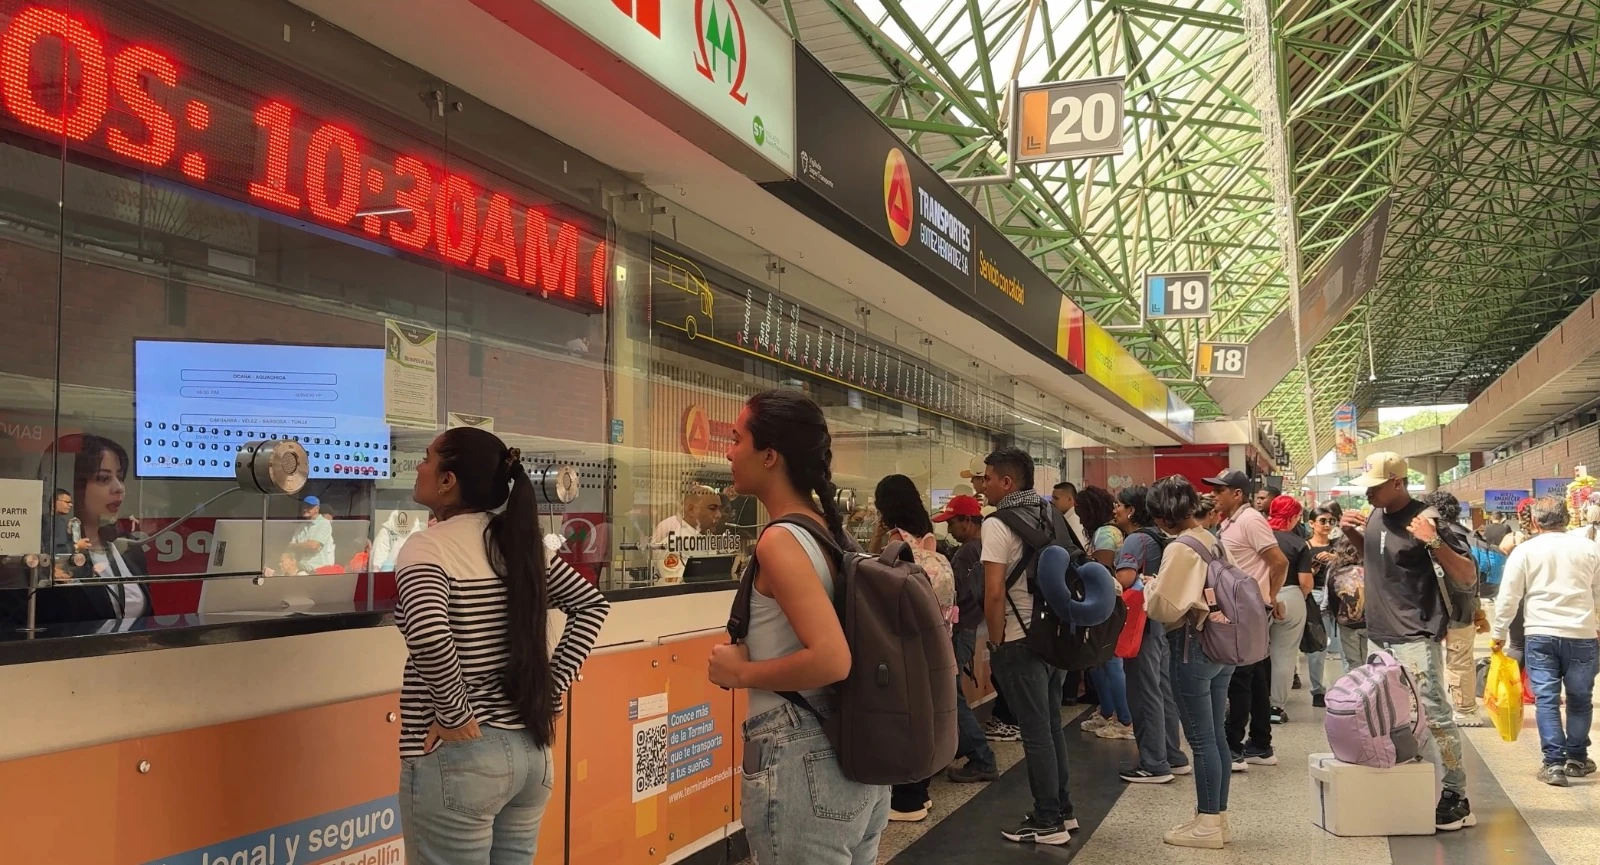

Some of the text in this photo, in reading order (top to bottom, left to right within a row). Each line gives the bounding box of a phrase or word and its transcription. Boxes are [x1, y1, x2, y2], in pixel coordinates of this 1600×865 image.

[1050, 92, 1115, 145] 20
[249, 100, 578, 298] 10:30AM
[918, 186, 971, 252] TRANSPORTES
[1167, 280, 1204, 310] 19
[1213, 350, 1242, 373] 18
[1, 507, 28, 515] PARTIR
[668, 529, 741, 552] Encomiendas
[670, 705, 709, 726] Conoce más
[670, 720, 714, 745] de la Terminal
[670, 735, 723, 765] que te transporta
[670, 758, 711, 781] a tus sueños.
[285, 834, 300, 865] y
[308, 807, 395, 852] seguro
